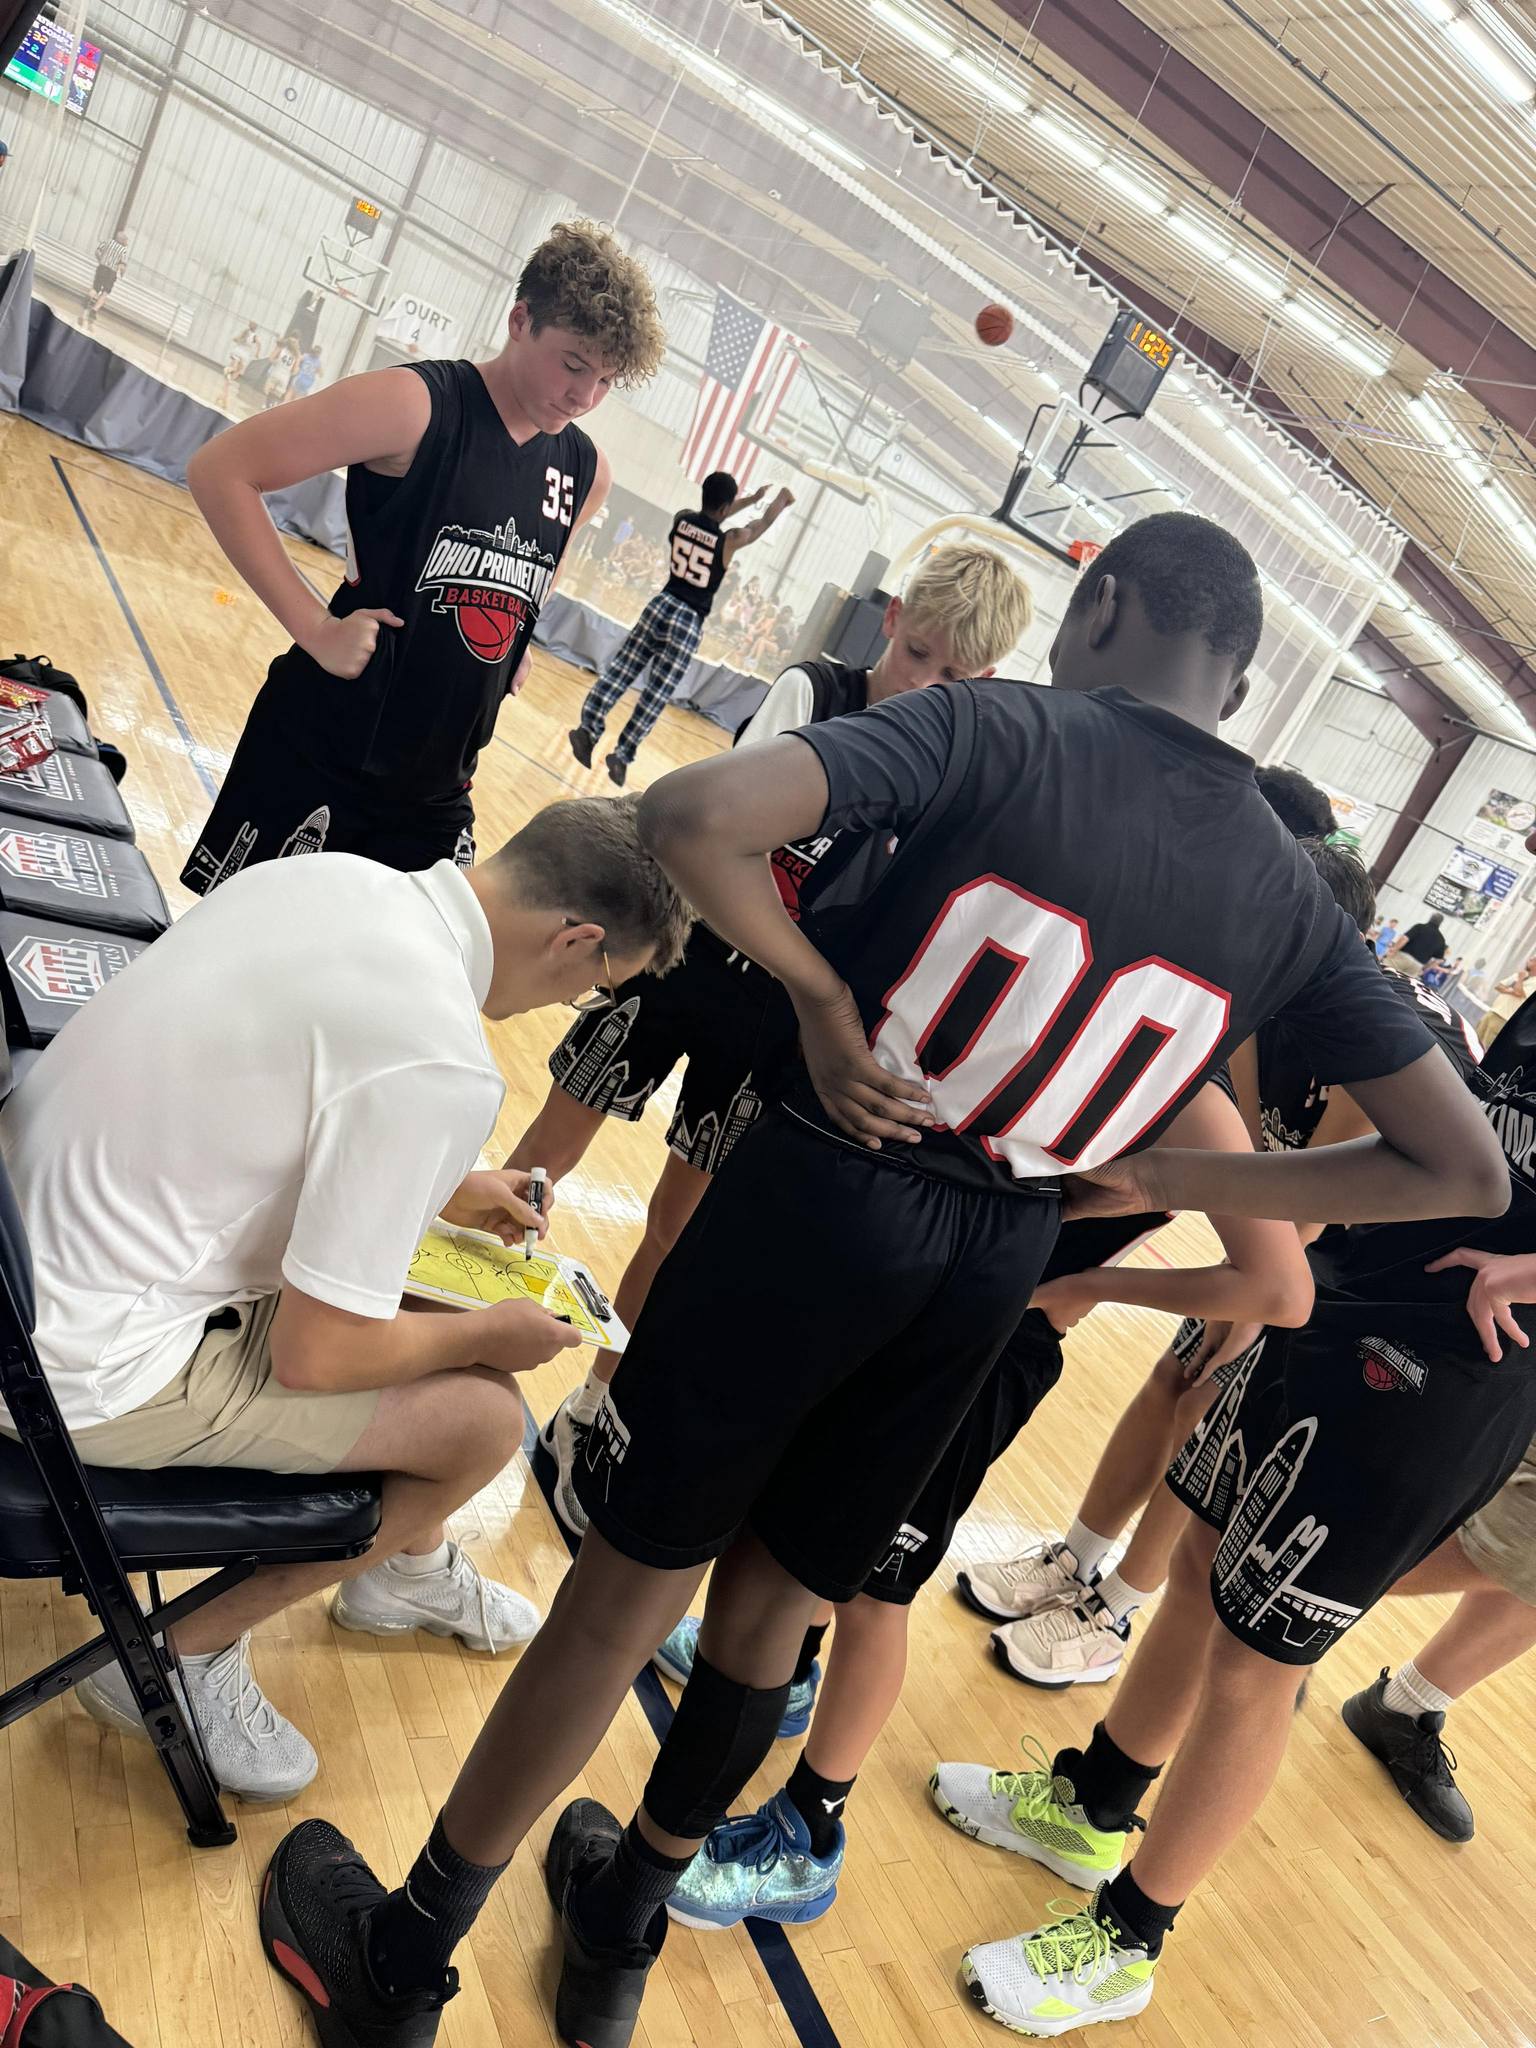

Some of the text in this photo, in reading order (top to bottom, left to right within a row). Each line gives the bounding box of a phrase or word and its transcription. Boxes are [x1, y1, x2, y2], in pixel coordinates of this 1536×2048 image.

[404, 299, 452, 332] OURT
[1131, 322, 1173, 368] 11:25
[426, 539, 480, 579] OHIO
[671, 535, 714, 588] 55
[446, 587, 528, 622] BASKETBALL
[868, 872, 1233, 1180] 00
[1360, 1336, 1424, 1389] OHIO PRIMETIME
